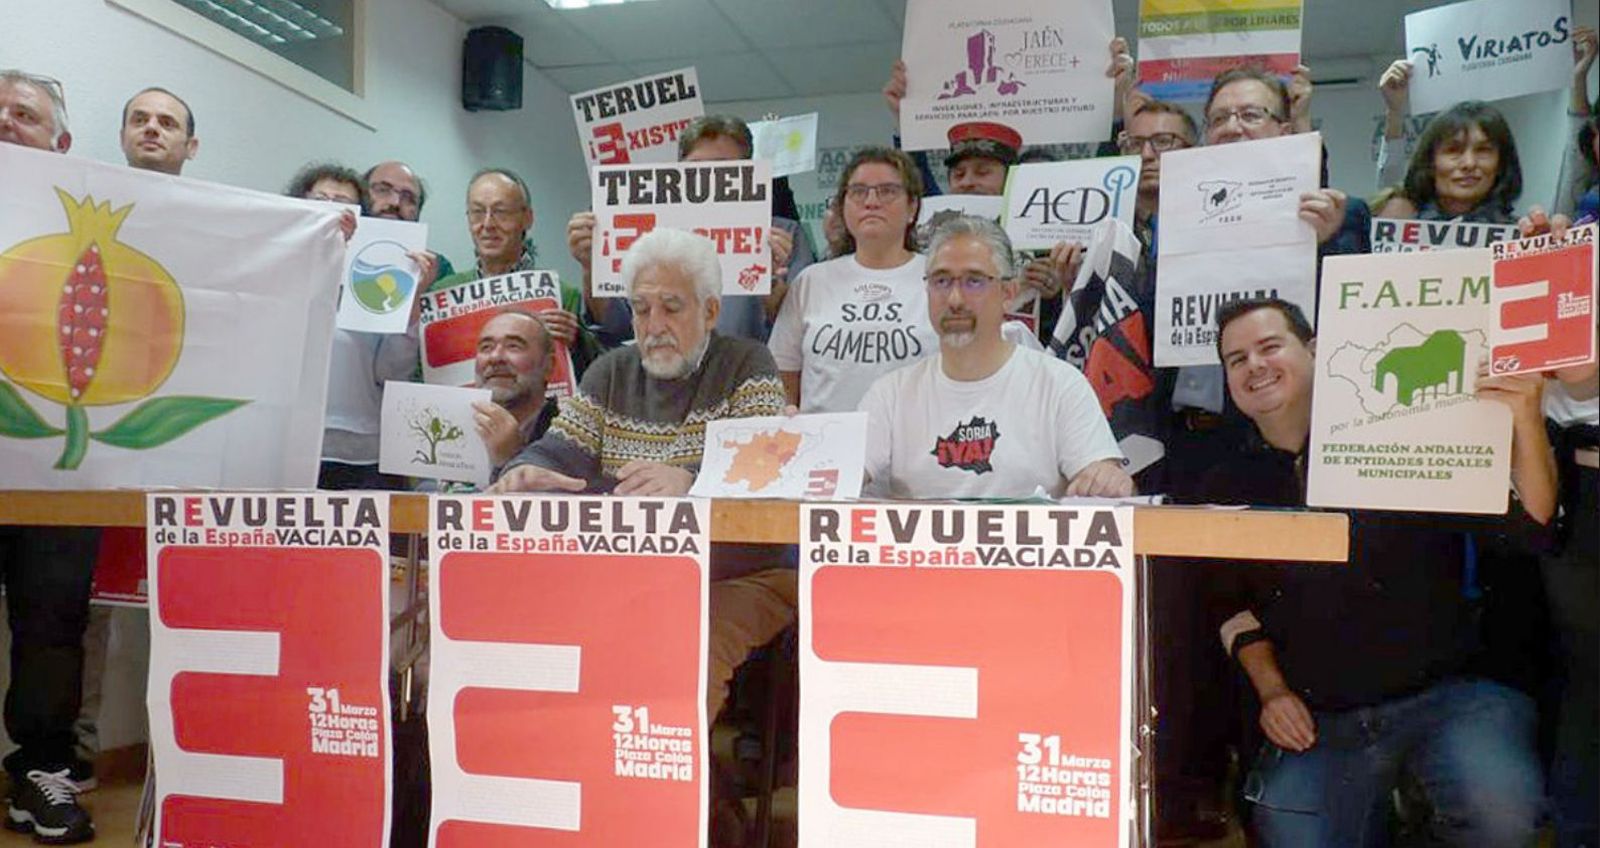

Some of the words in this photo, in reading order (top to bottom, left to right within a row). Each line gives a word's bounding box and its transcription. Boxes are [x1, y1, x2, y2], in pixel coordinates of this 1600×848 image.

[577, 73, 696, 122] TERUEL
[598, 165, 766, 205] TERUEL
[419, 273, 556, 313] REVUELTA
[420, 312, 436, 325] de
[438, 307, 448, 318] la
[842, 302, 903, 322] S.O.S.
[812, 324, 922, 363] CAMEROS
[1171, 328, 1182, 346] de
[1184, 327, 1194, 345] la
[958, 424, 992, 442] SORIA
[1330, 422, 1350, 435] por
[1354, 416, 1364, 427] la
[1322, 442, 1410, 454] FEDERACIÓN
[1414, 445, 1495, 455] ANDALUZA
[1323, 456, 1342, 465] DE
[1344, 456, 1424, 466] ENTIDADES
[1428, 457, 1493, 468] LOCALES
[1358, 468, 1453, 480] MUNICIPALES
[154, 497, 380, 528] REVUELTA
[437, 499, 700, 534] REVUELTA
[155, 528, 176, 544] de
[183, 528, 198, 544] la
[809, 508, 1122, 547] REVUELTA
[438, 533, 462, 550] de
[470, 534, 488, 550] la
[810, 545, 838, 564] de
[848, 545, 870, 564] la
[307, 687, 340, 713] 31
[340, 704, 377, 716] Marzo
[612, 705, 649, 734] 31
[650, 724, 692, 737] Marzo
[312, 728, 344, 740] Plaza
[312, 740, 379, 758] Madrid
[615, 749, 651, 762] Plaza
[1016, 732, 1060, 766] 31
[1061, 754, 1112, 769] Marzo
[615, 760, 693, 782] Madrid
[1018, 784, 1062, 797] Plaza
[1017, 795, 1110, 818] Madrid
